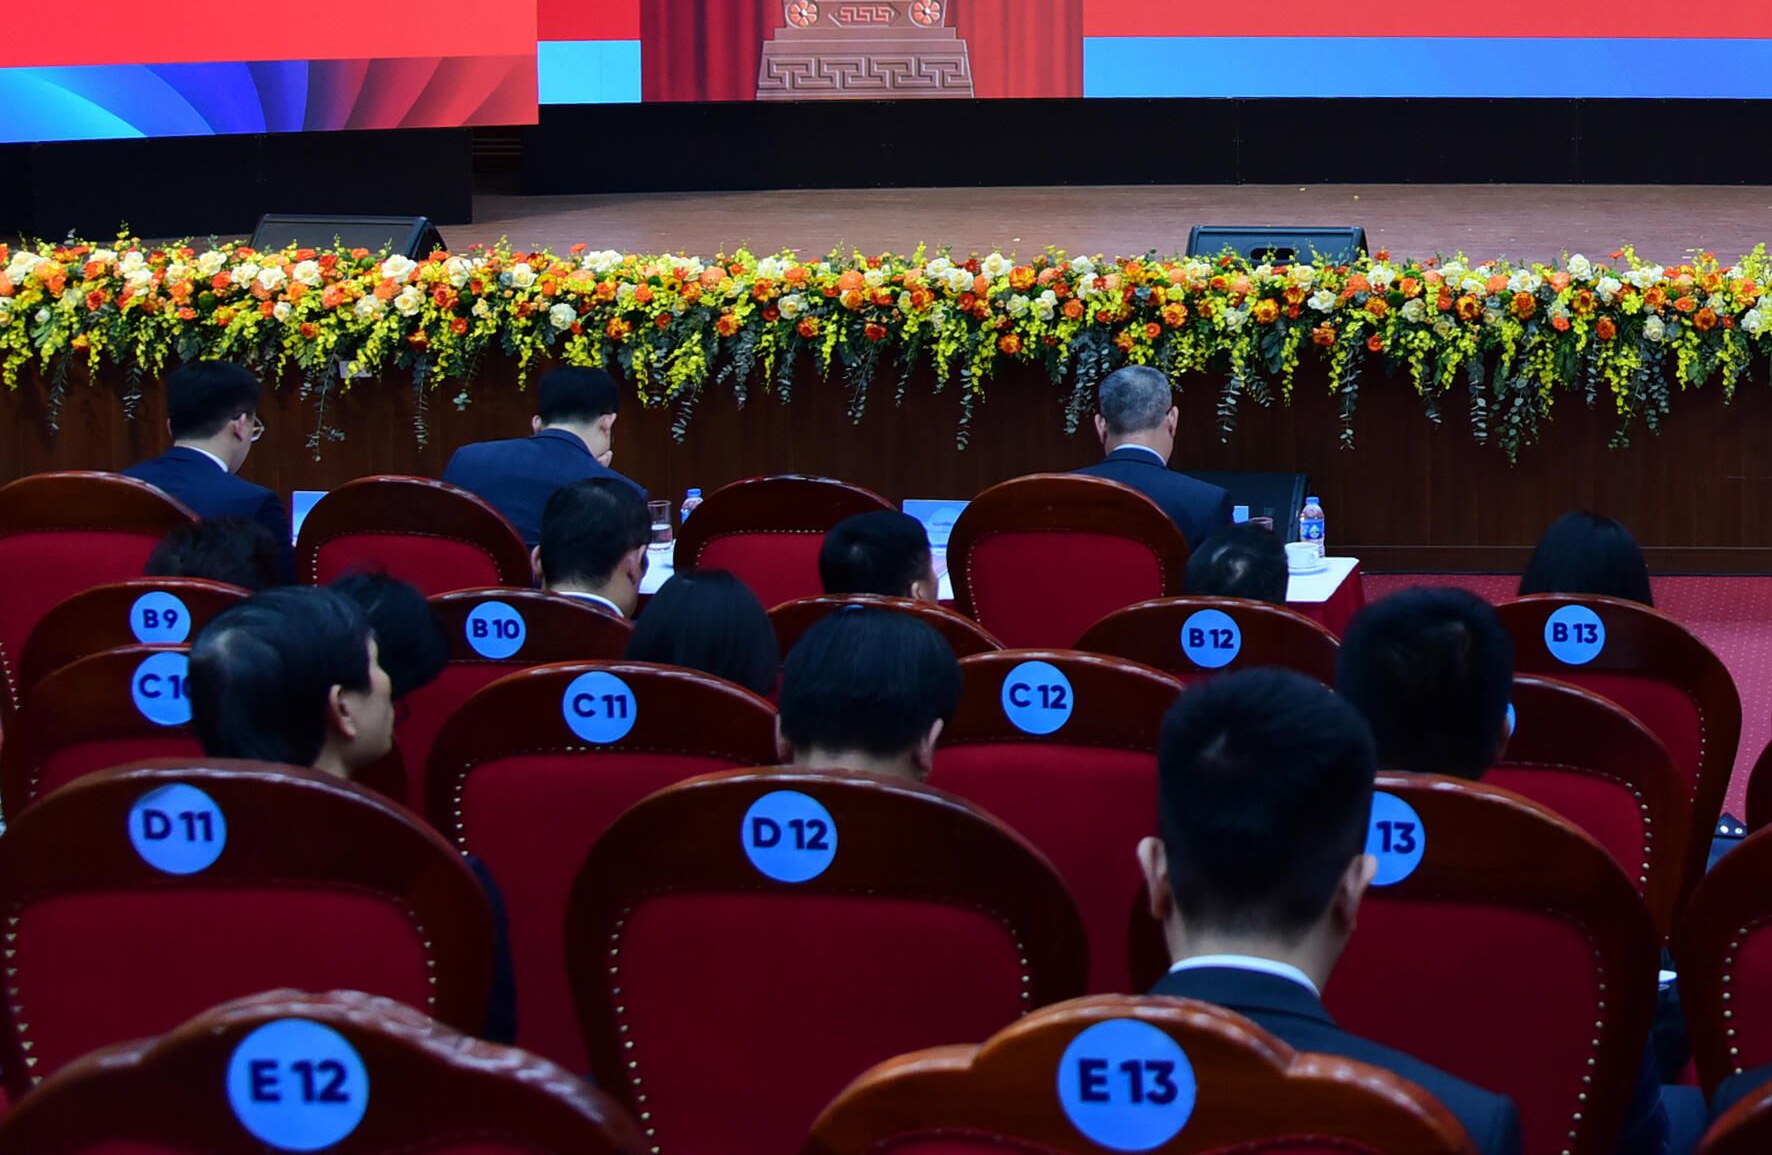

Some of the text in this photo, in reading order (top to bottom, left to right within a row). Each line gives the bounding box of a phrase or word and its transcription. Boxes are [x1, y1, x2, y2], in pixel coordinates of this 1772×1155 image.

[143, 608, 178, 629] B 9
[472, 618, 520, 640] B 10
[1189, 627, 1235, 649] B 12
[1552, 622, 1598, 644] B 13
[138, 673, 162, 699] C
[1009, 682, 1067, 710] C 12
[572, 692, 628, 719] C 11
[142, 808, 214, 843] D 11
[752, 816, 829, 851] D 12
[1376, 820, 1417, 855] 13
[249, 1059, 350, 1104] E 12
[1077, 1057, 1179, 1106] E 13
